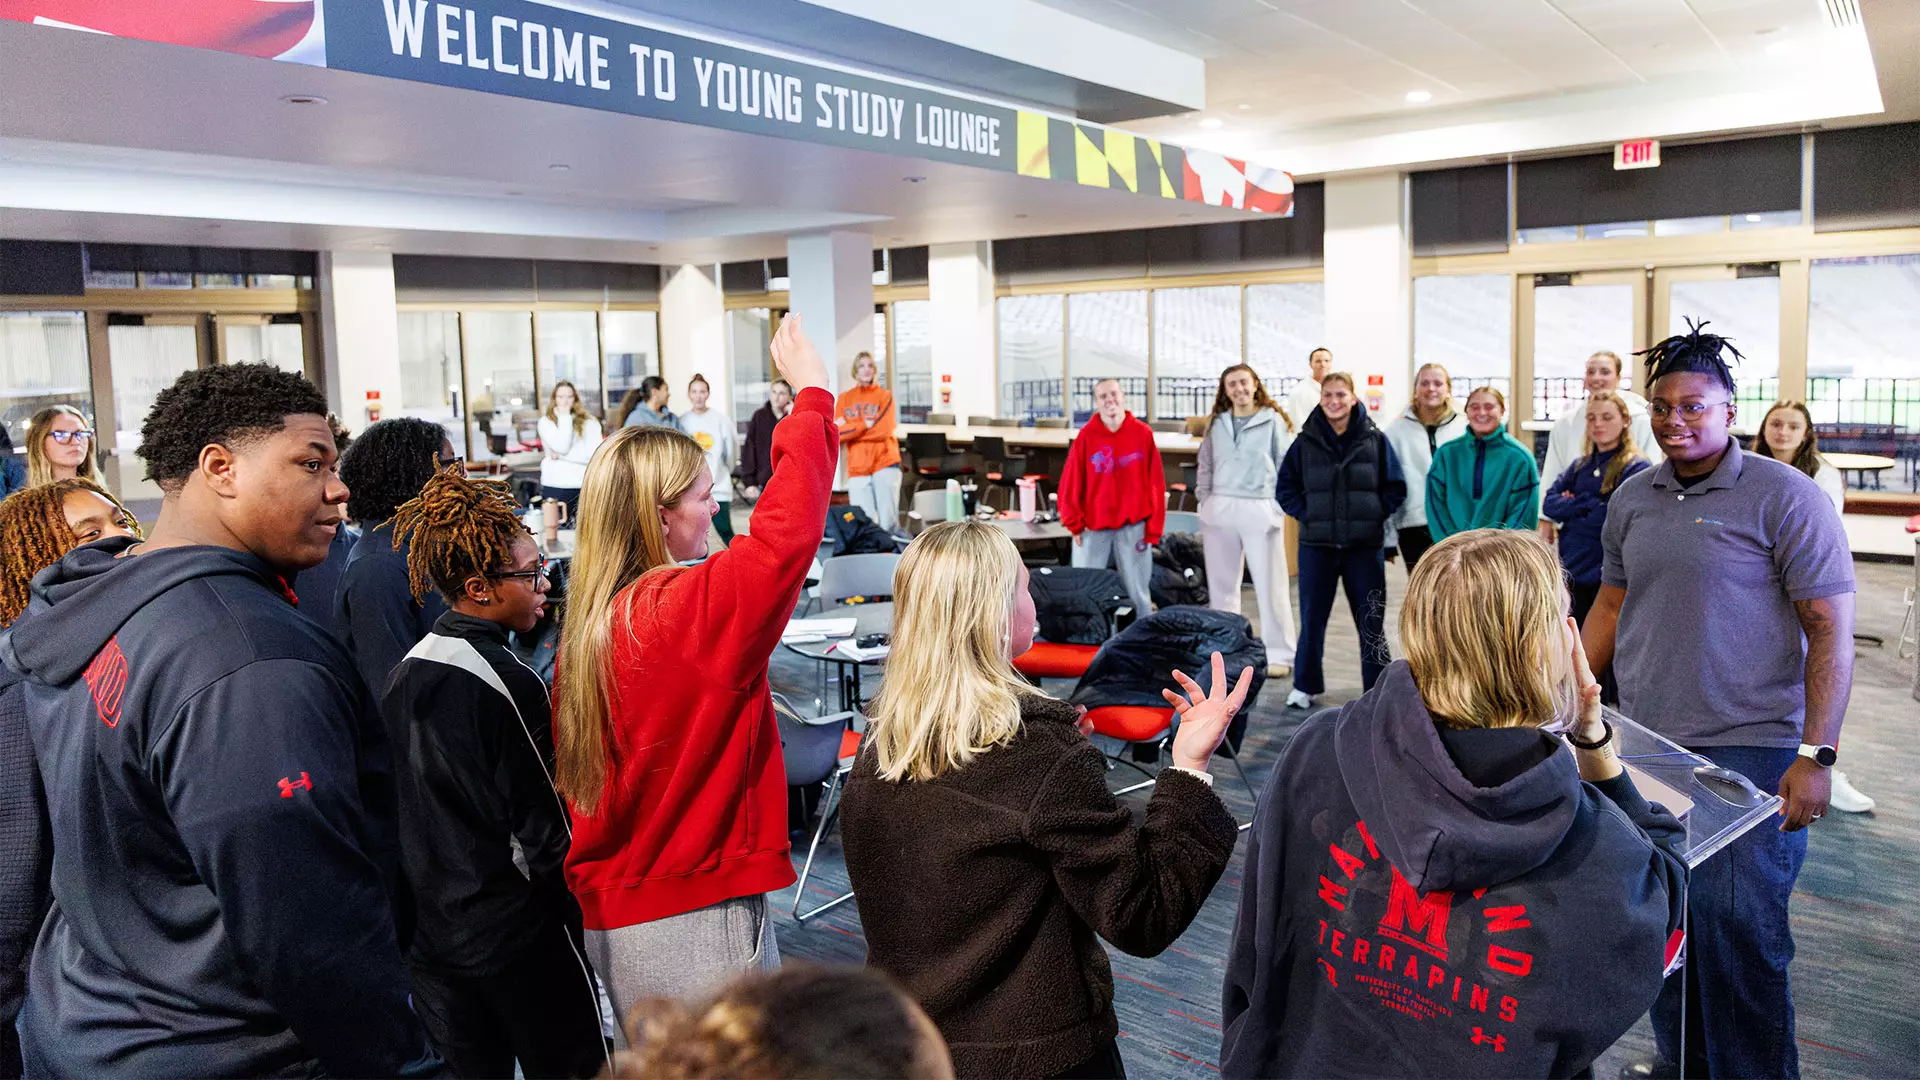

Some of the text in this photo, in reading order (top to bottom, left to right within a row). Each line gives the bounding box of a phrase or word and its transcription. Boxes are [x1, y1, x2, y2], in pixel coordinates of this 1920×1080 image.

[382, 0, 1001, 157] WELCOME TO YOUNG STUDY LOUNGE
[1622, 141, 1653, 164] EXIT
[1318, 919, 1519, 1023] TERRAPINS
